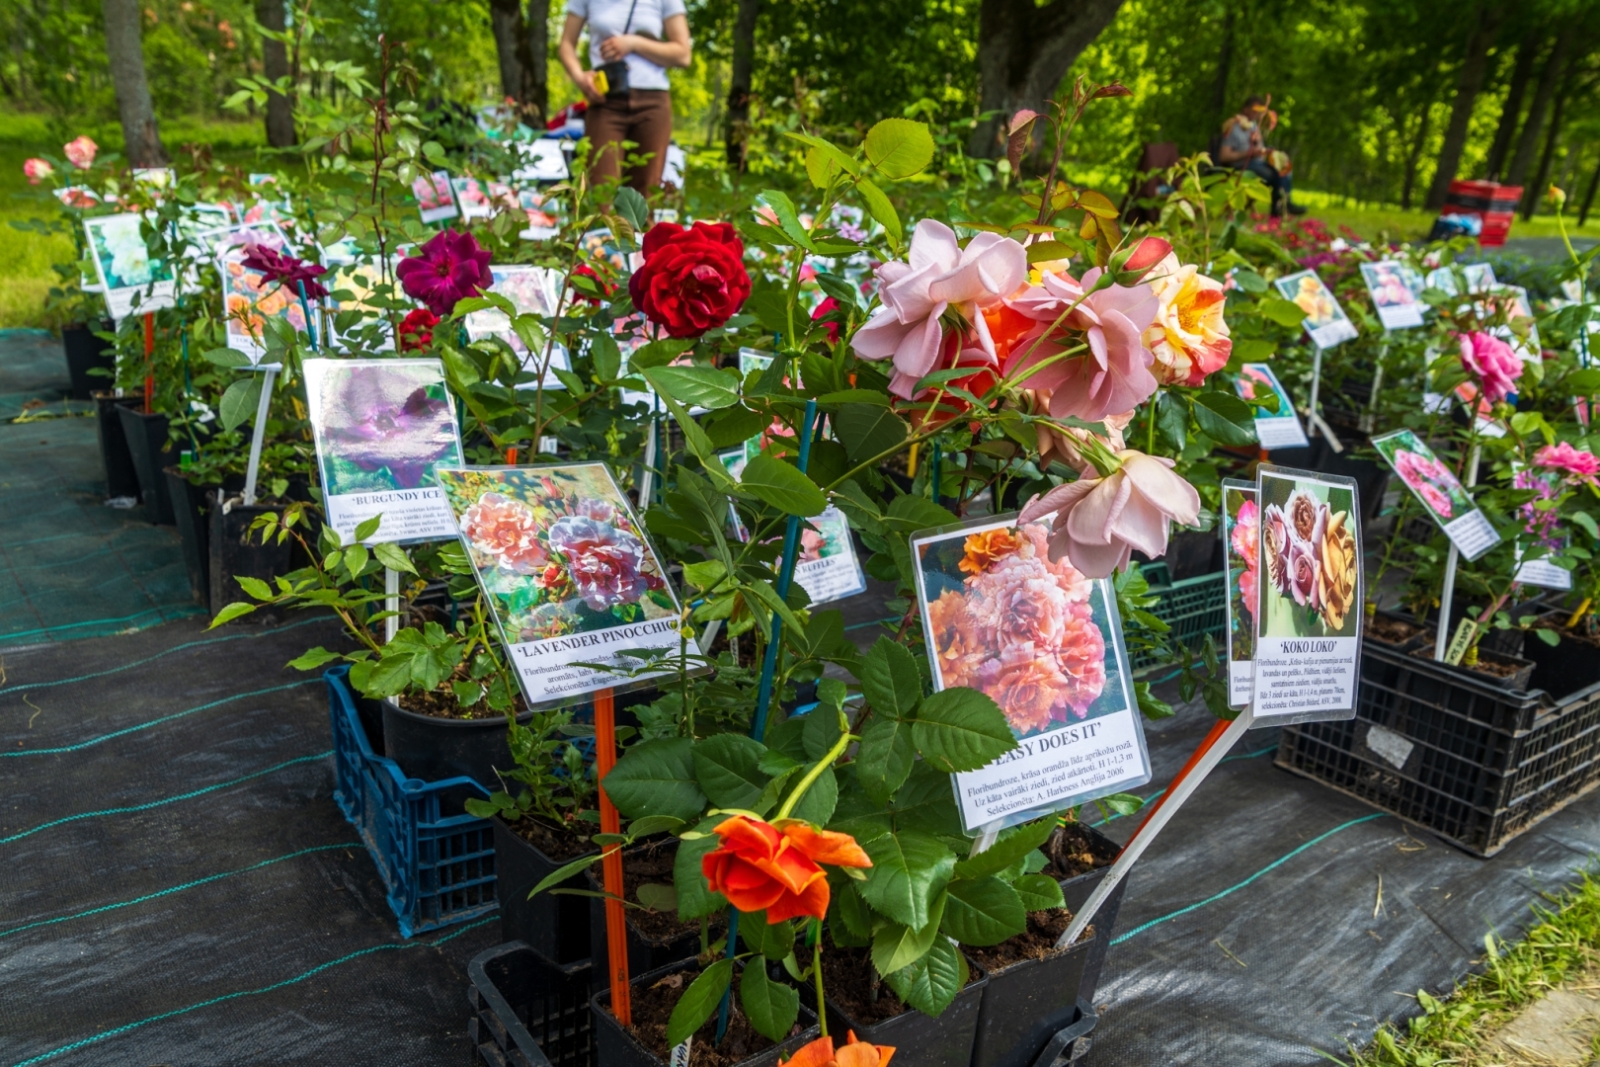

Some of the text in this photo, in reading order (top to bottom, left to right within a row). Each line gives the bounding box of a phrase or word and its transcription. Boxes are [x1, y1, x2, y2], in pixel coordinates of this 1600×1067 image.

[422, 490, 441, 499] ICE
[1280, 641, 1337, 653] ‘KOKO LOKO’
[543, 680, 591, 695] Selekcionēta:
[592, 676, 618, 686] Eugene
[547, 672, 578, 684] aromāts,
[578, 668, 592, 677] labi
[1038, 729, 1079, 752] DOES
[967, 740, 1132, 797] Floribundroze, krāsa orandža līdz aprikožu rozā.
[975, 798, 986, 807] Uz
[986, 792, 1002, 803] kāta
[1004, 783, 1028, 798] vairāki
[1030, 778, 1050, 790] ziedi,
[1051, 773, 1066, 783] zied
[1066, 763, 1096, 778] atkārtoti.
[1098, 760, 1105, 768] H
[1107, 754, 1124, 766] 1-1,3
[987, 766, 1124, 816] Selekcionēta: A. Harkness Anglija 2006
